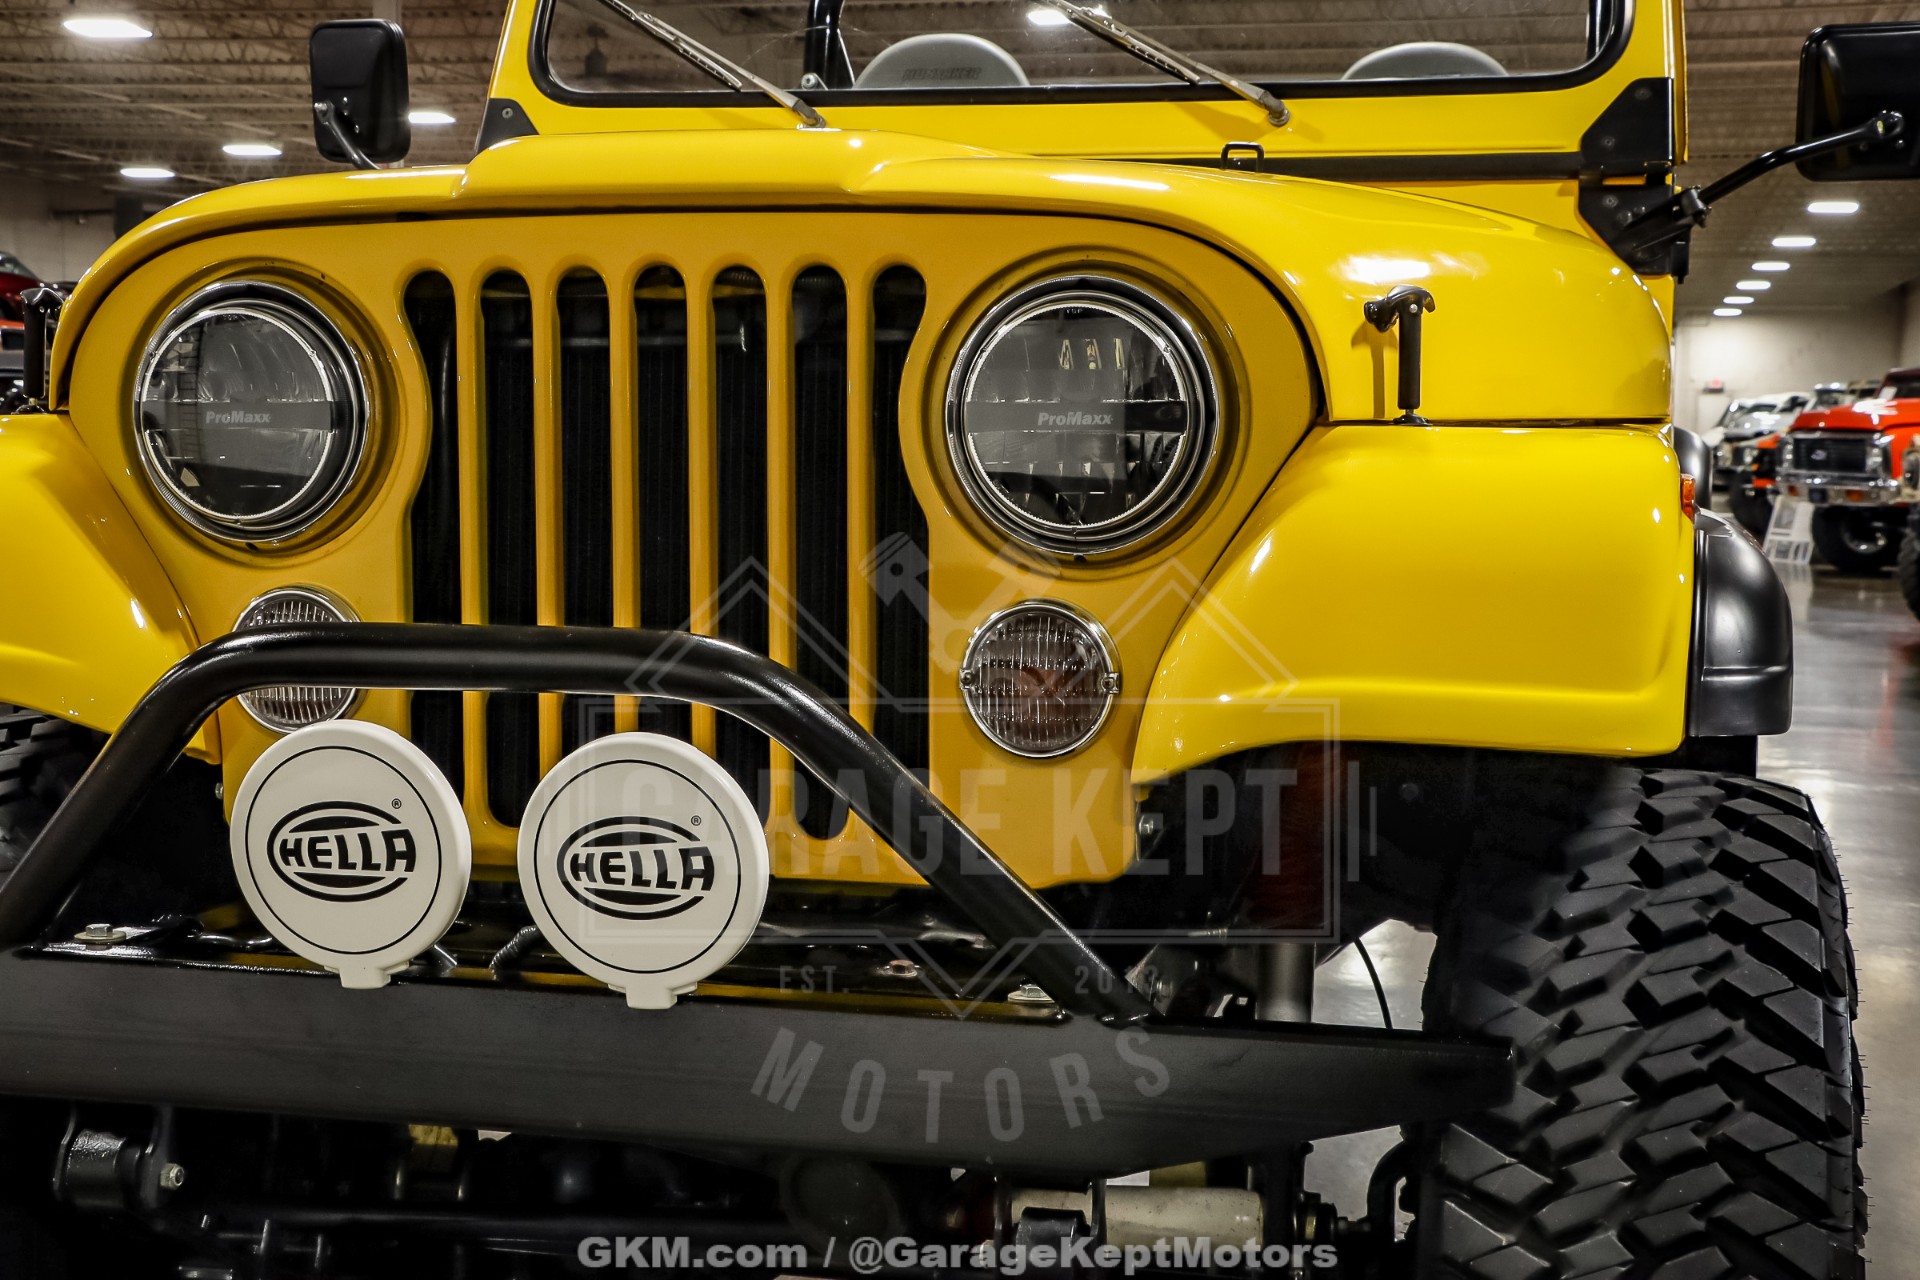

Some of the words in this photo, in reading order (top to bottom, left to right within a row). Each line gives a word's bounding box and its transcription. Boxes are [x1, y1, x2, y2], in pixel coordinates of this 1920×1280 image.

[206, 410, 271, 424] ProMaxx
[1037, 411, 1114, 425] ProMaxx
[279, 829, 416, 872] HELLA
[569, 846, 715, 891] HELLA
